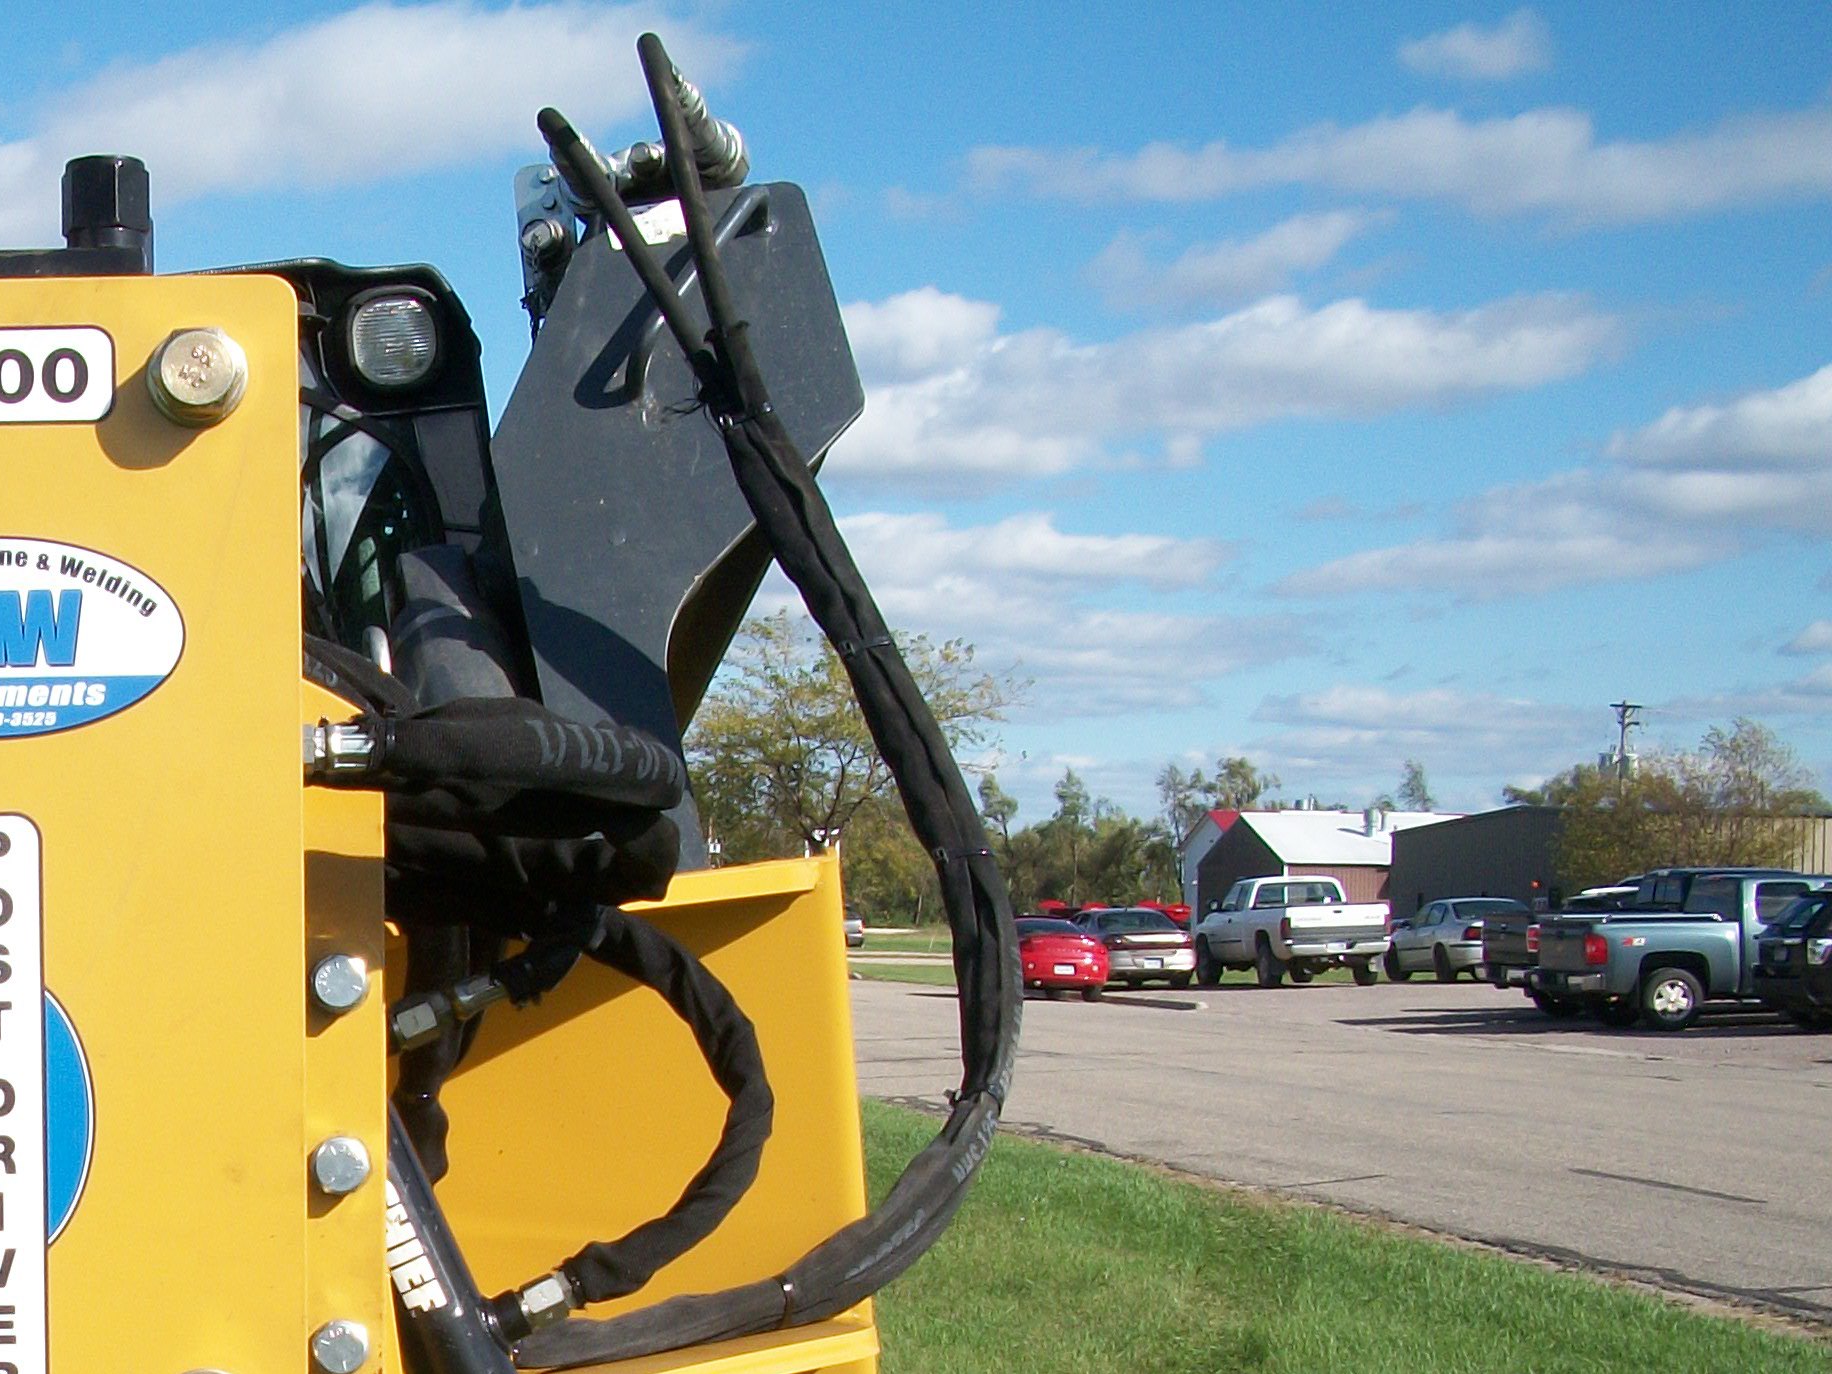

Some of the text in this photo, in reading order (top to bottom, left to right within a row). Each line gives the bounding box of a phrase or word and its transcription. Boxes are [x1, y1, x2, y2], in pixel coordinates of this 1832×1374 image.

[36, 554, 52, 571] &
[59, 554, 158, 619] Welding
[385, 1180, 448, 1312] HIEF
